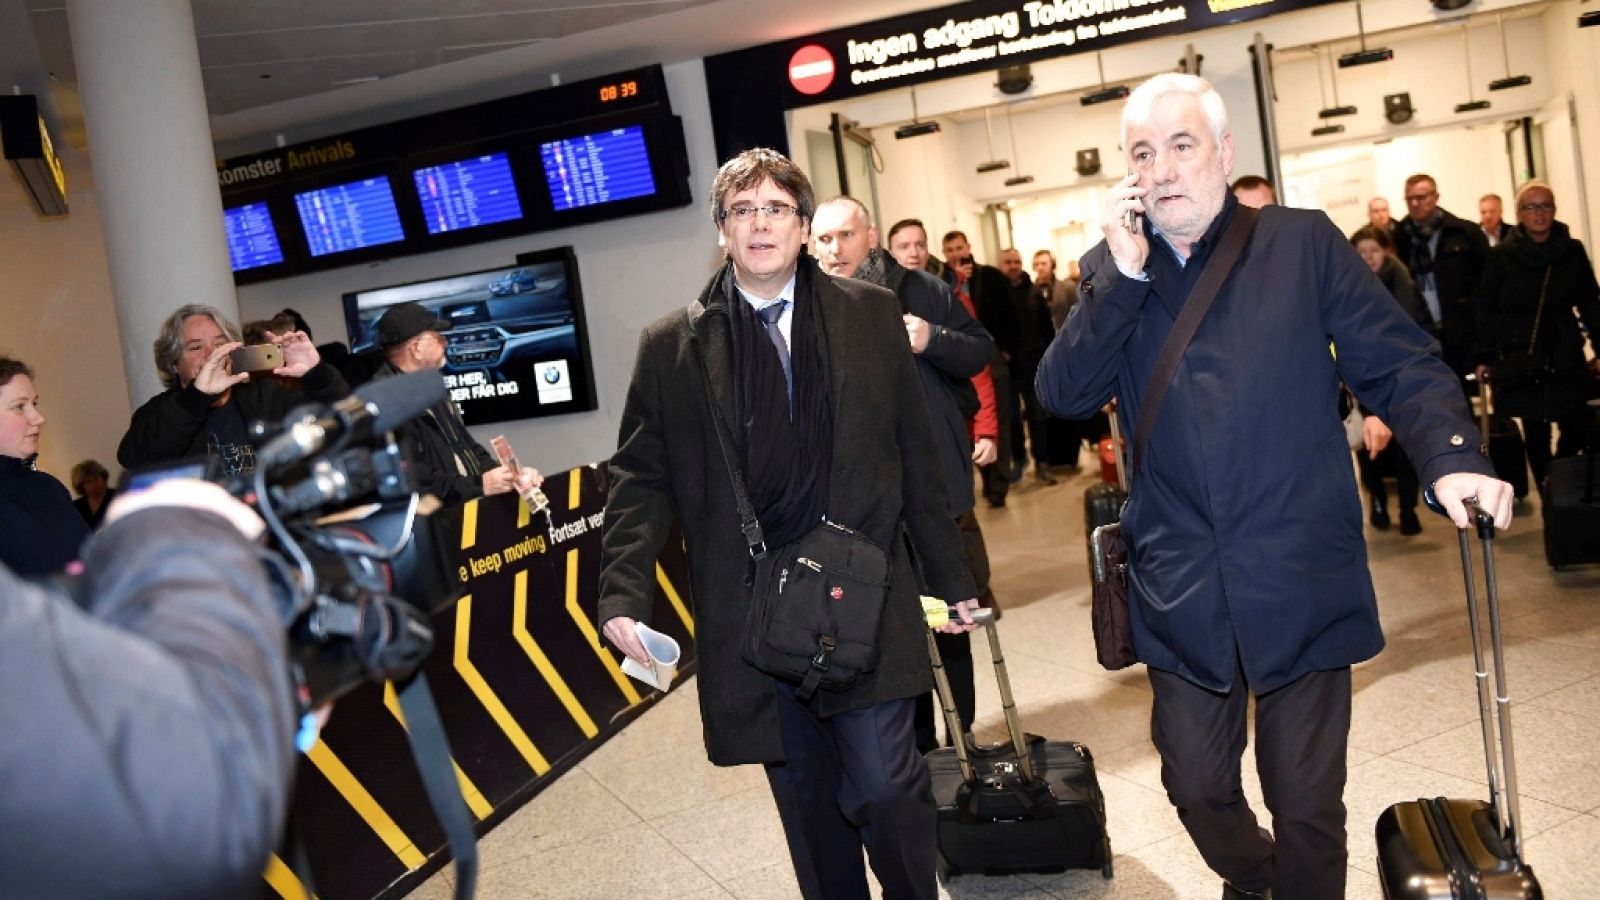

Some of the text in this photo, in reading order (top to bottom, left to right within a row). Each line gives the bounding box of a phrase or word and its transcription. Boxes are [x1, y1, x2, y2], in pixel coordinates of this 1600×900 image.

[847, 33, 917, 65] Ingen
[923, 11, 1019, 48] adgang
[600, 81, 637, 102] 08 39
[288, 140, 355, 170] Arrivals
[458, 371, 487, 387] HER,
[496, 380, 519, 396] DIG
[469, 552, 503, 578] keep
[503, 535, 547, 564] moving
[549, 516, 588, 545] Fortsæt
